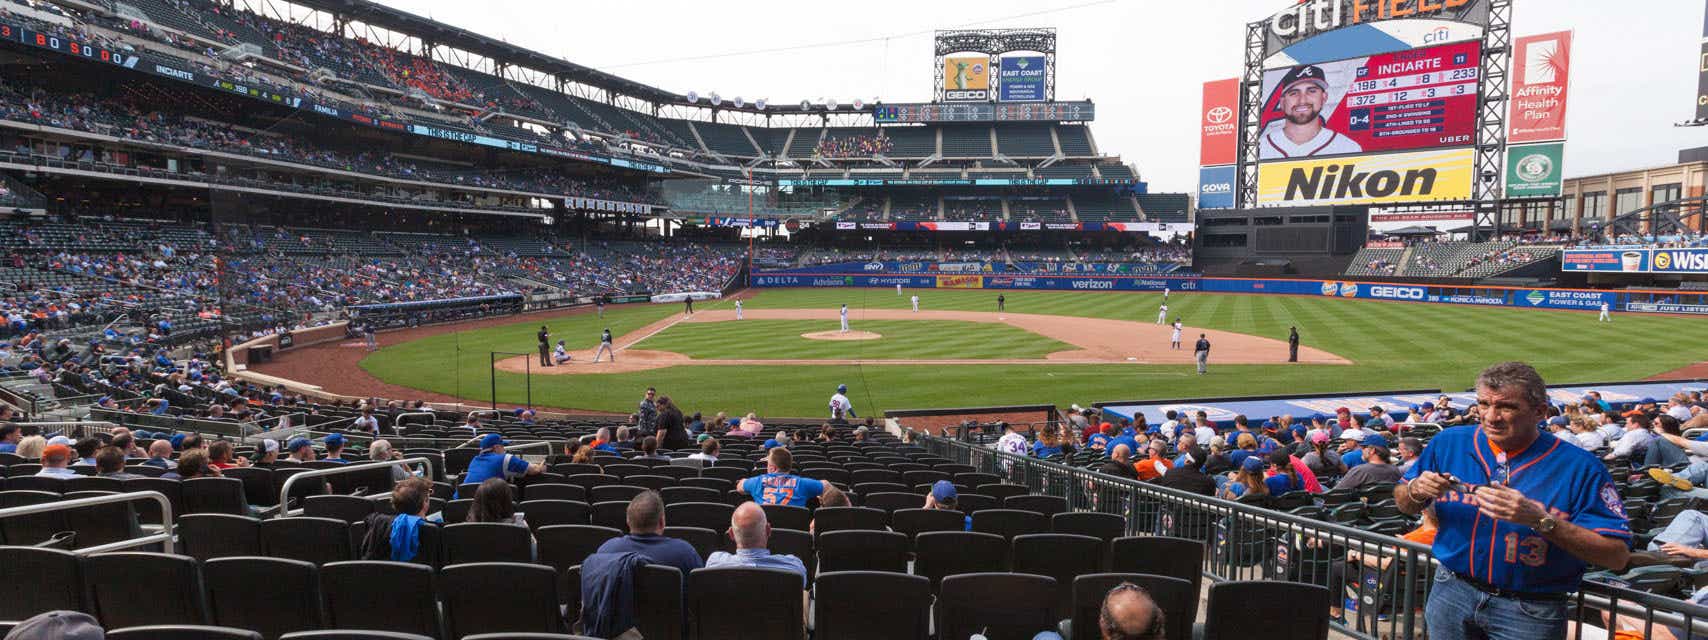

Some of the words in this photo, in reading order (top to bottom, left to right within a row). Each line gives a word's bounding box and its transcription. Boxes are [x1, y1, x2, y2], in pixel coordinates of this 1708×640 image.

[1271, 0, 1341, 36] citi
[1352, 0, 1469, 23] FIE
[1423, 27, 1449, 43] citi
[36, 34, 46, 45] B
[69, 42, 79, 54] S
[1455, 55, 1465, 63] 11
[1378, 57, 1442, 75] INCIARTE
[155, 64, 194, 81] INCIARTE
[1357, 68, 1369, 77] CF
[1354, 81, 1376, 92] .198
[1388, 78, 1397, 87] 4
[1422, 74, 1430, 83] 8
[1449, 68, 1476, 80] .233
[946, 91, 986, 99] GEICO
[1353, 95, 1376, 106] .372
[1394, 92, 1407, 101] 12
[1427, 88, 1435, 97] 3
[1456, 85, 1464, 94] 3
[1516, 85, 1563, 97] Affinity
[1518, 98, 1559, 110] Health
[314, 104, 338, 117] FAMILIA
[1524, 110, 1550, 120] Plan
[428, 127, 442, 138] THIS
[1203, 123, 1234, 132] TOYOTA
[1440, 135, 1470, 143] UBER
[1283, 164, 1437, 201] Nikon
[767, 276, 799, 284] DELTA
[1072, 279, 1113, 289] verizon
[1181, 279, 1196, 289] citi
[1370, 286, 1424, 299] GEICO
[1451, 296, 1474, 304] KONICA
[1009, 441, 1025, 453] 34
[763, 487, 794, 505] 57
[1504, 532, 1548, 567] 13
